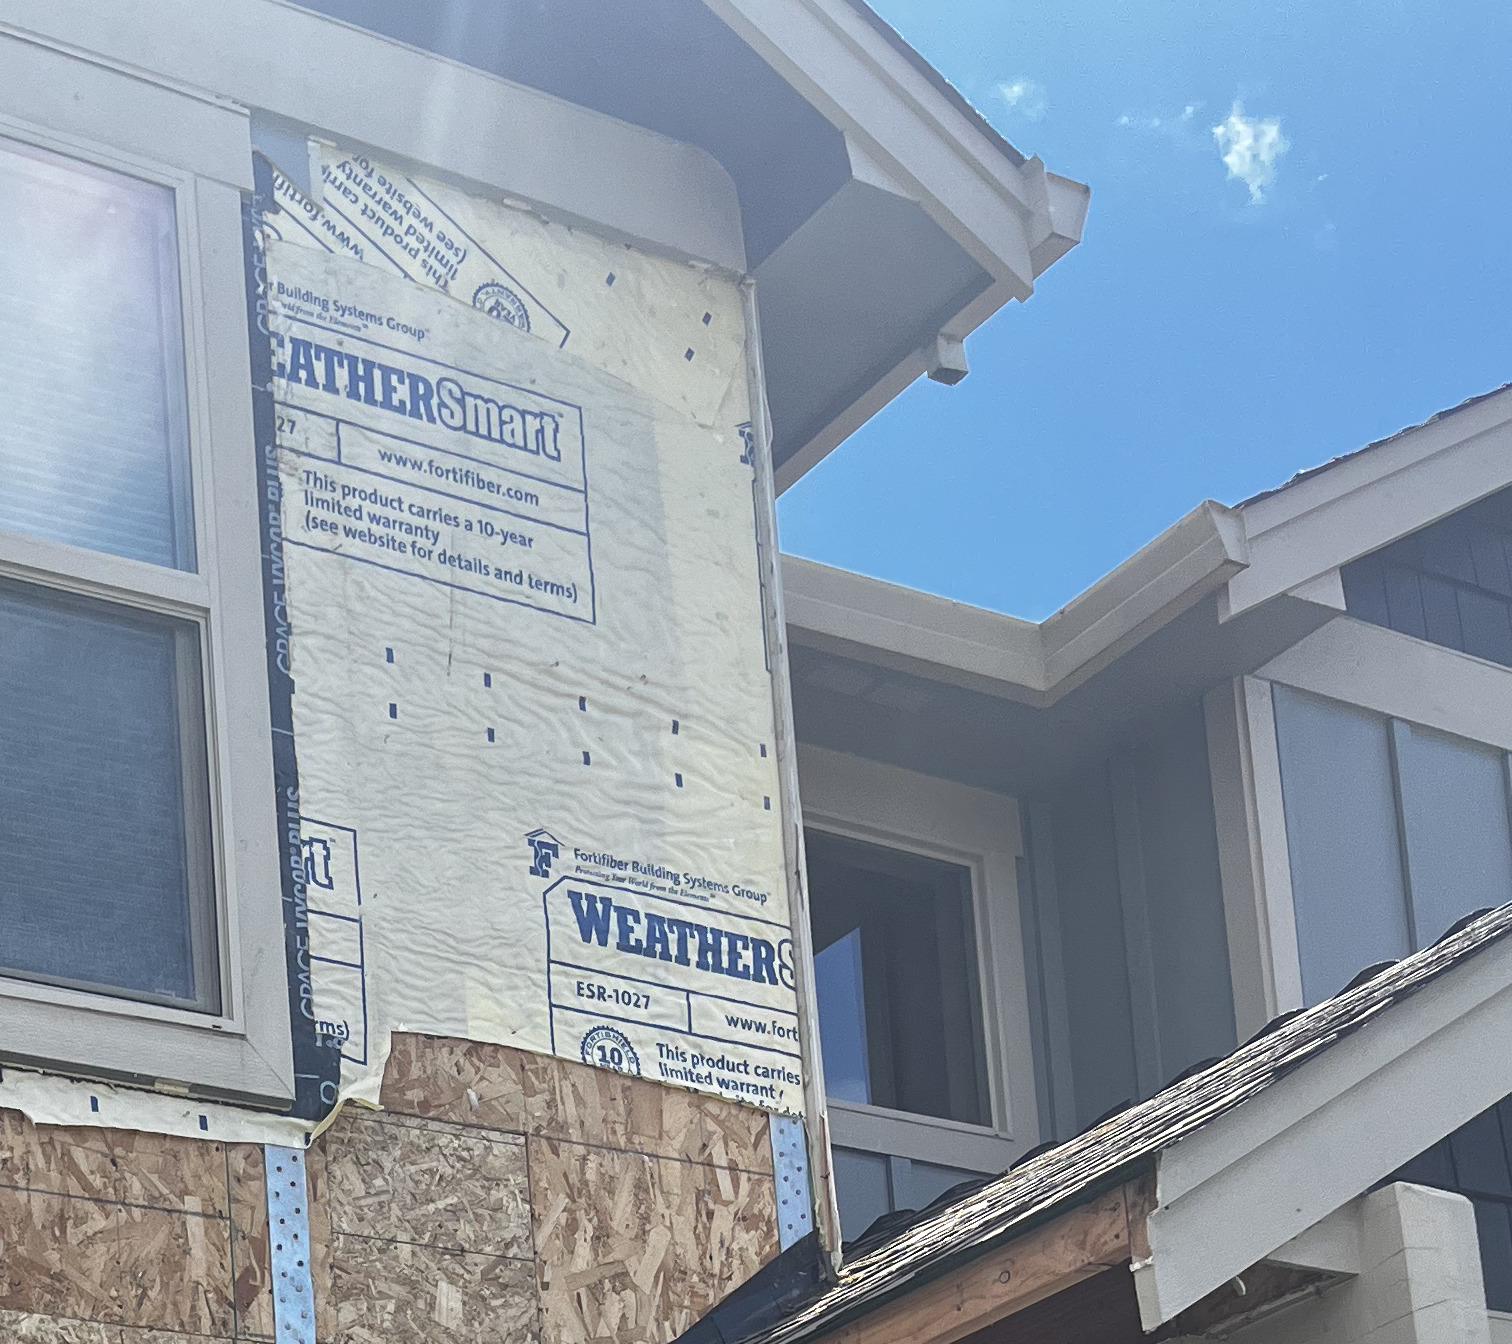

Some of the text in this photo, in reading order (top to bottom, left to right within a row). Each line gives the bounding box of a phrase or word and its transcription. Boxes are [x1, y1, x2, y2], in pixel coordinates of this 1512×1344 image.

[360, 205, 419, 260] product
[277, 282, 330, 312] Building
[333, 300, 385, 326] Systems
[377, 449, 539, 507] www.fortifiber.com
[303, 469, 534, 549] This product carries a 10-year
[303, 490, 441, 546] limited warranty
[305, 509, 578, 604] (see website for details and terms)
[574, 848, 628, 871] Fortifiber
[632, 861, 681, 886] Building
[683, 873, 729, 894] Systems
[576, 980, 651, 1010] ESR-1027
[596, 1045, 623, 1067] 10
[656, 1042, 801, 1086] This product carries
[658, 1062, 713, 1086] limited
